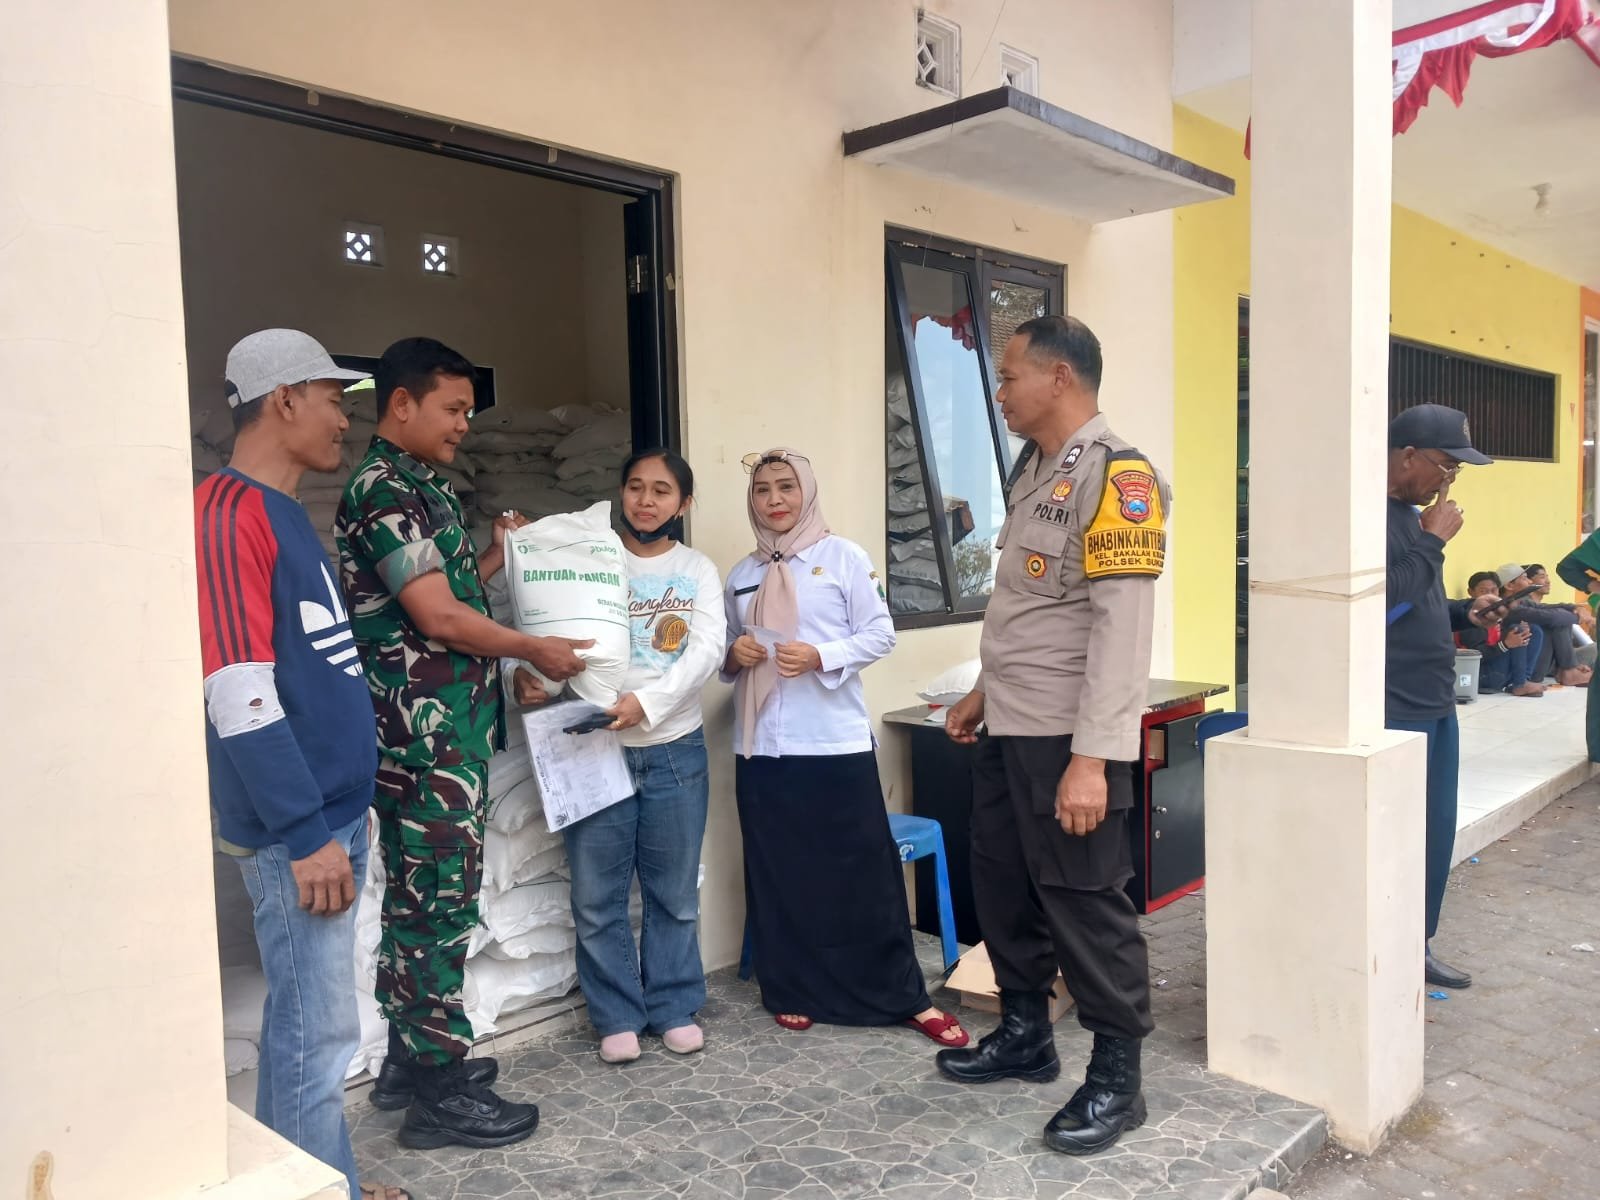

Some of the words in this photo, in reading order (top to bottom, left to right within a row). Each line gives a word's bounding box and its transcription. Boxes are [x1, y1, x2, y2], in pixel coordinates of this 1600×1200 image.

[1033, 503, 1069, 524] POLRI
[1098, 558, 1142, 568] POLSEK
[523, 569, 576, 583] BANTUAN
[578, 571, 620, 587] PANGAN
[627, 587, 694, 629] angkon
